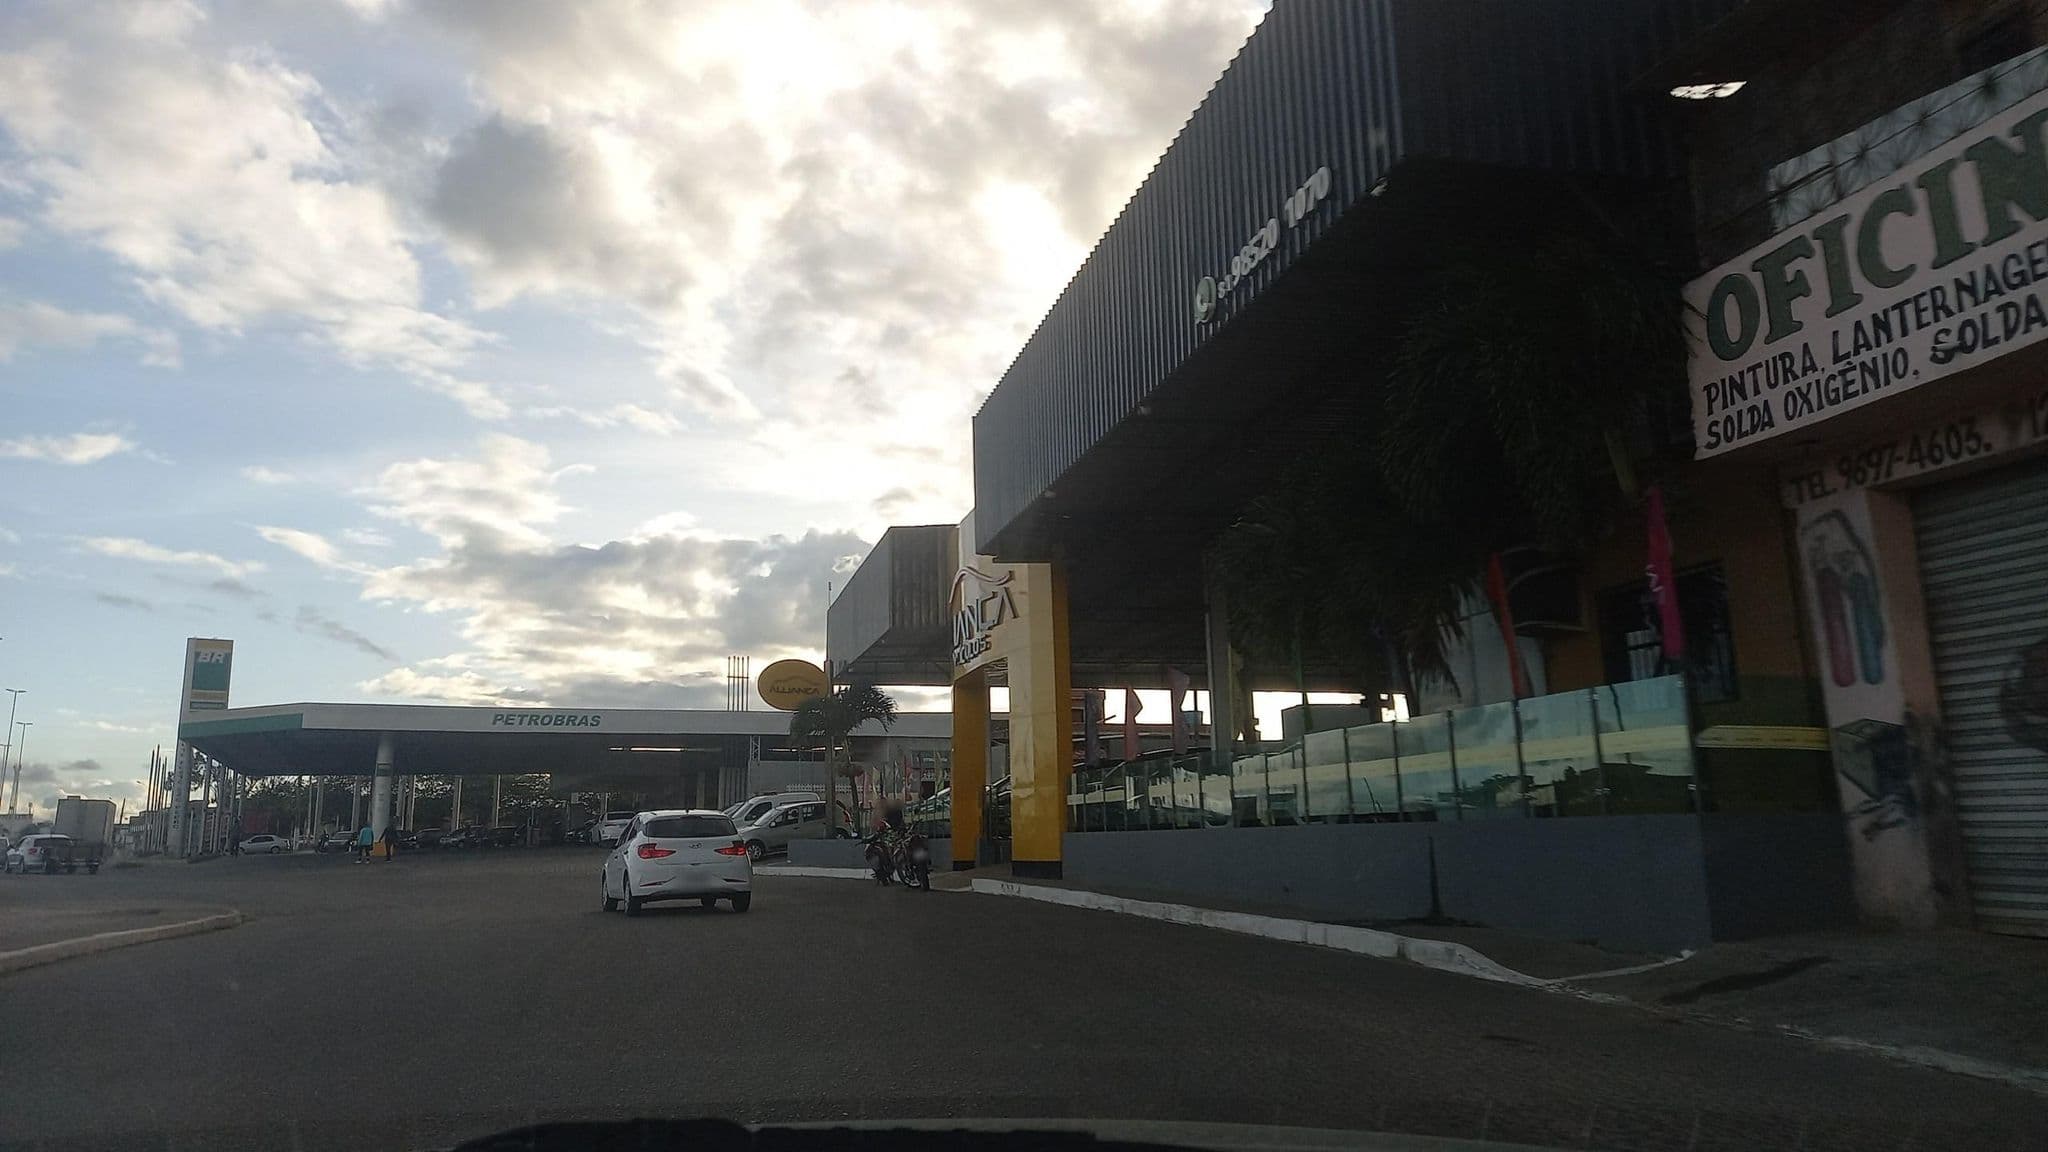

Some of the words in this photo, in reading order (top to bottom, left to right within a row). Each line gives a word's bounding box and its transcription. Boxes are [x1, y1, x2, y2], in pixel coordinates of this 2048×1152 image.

[1284, 166, 1332, 229] 1070
[1703, 342, 1826, 416] PINTURA,
[1706, 399, 1775, 450] SOLDA
[1930, 299, 2048, 366] SOLDA
[197, 650, 226, 666] BR
[491, 713, 602, 728] PETROBRAS
